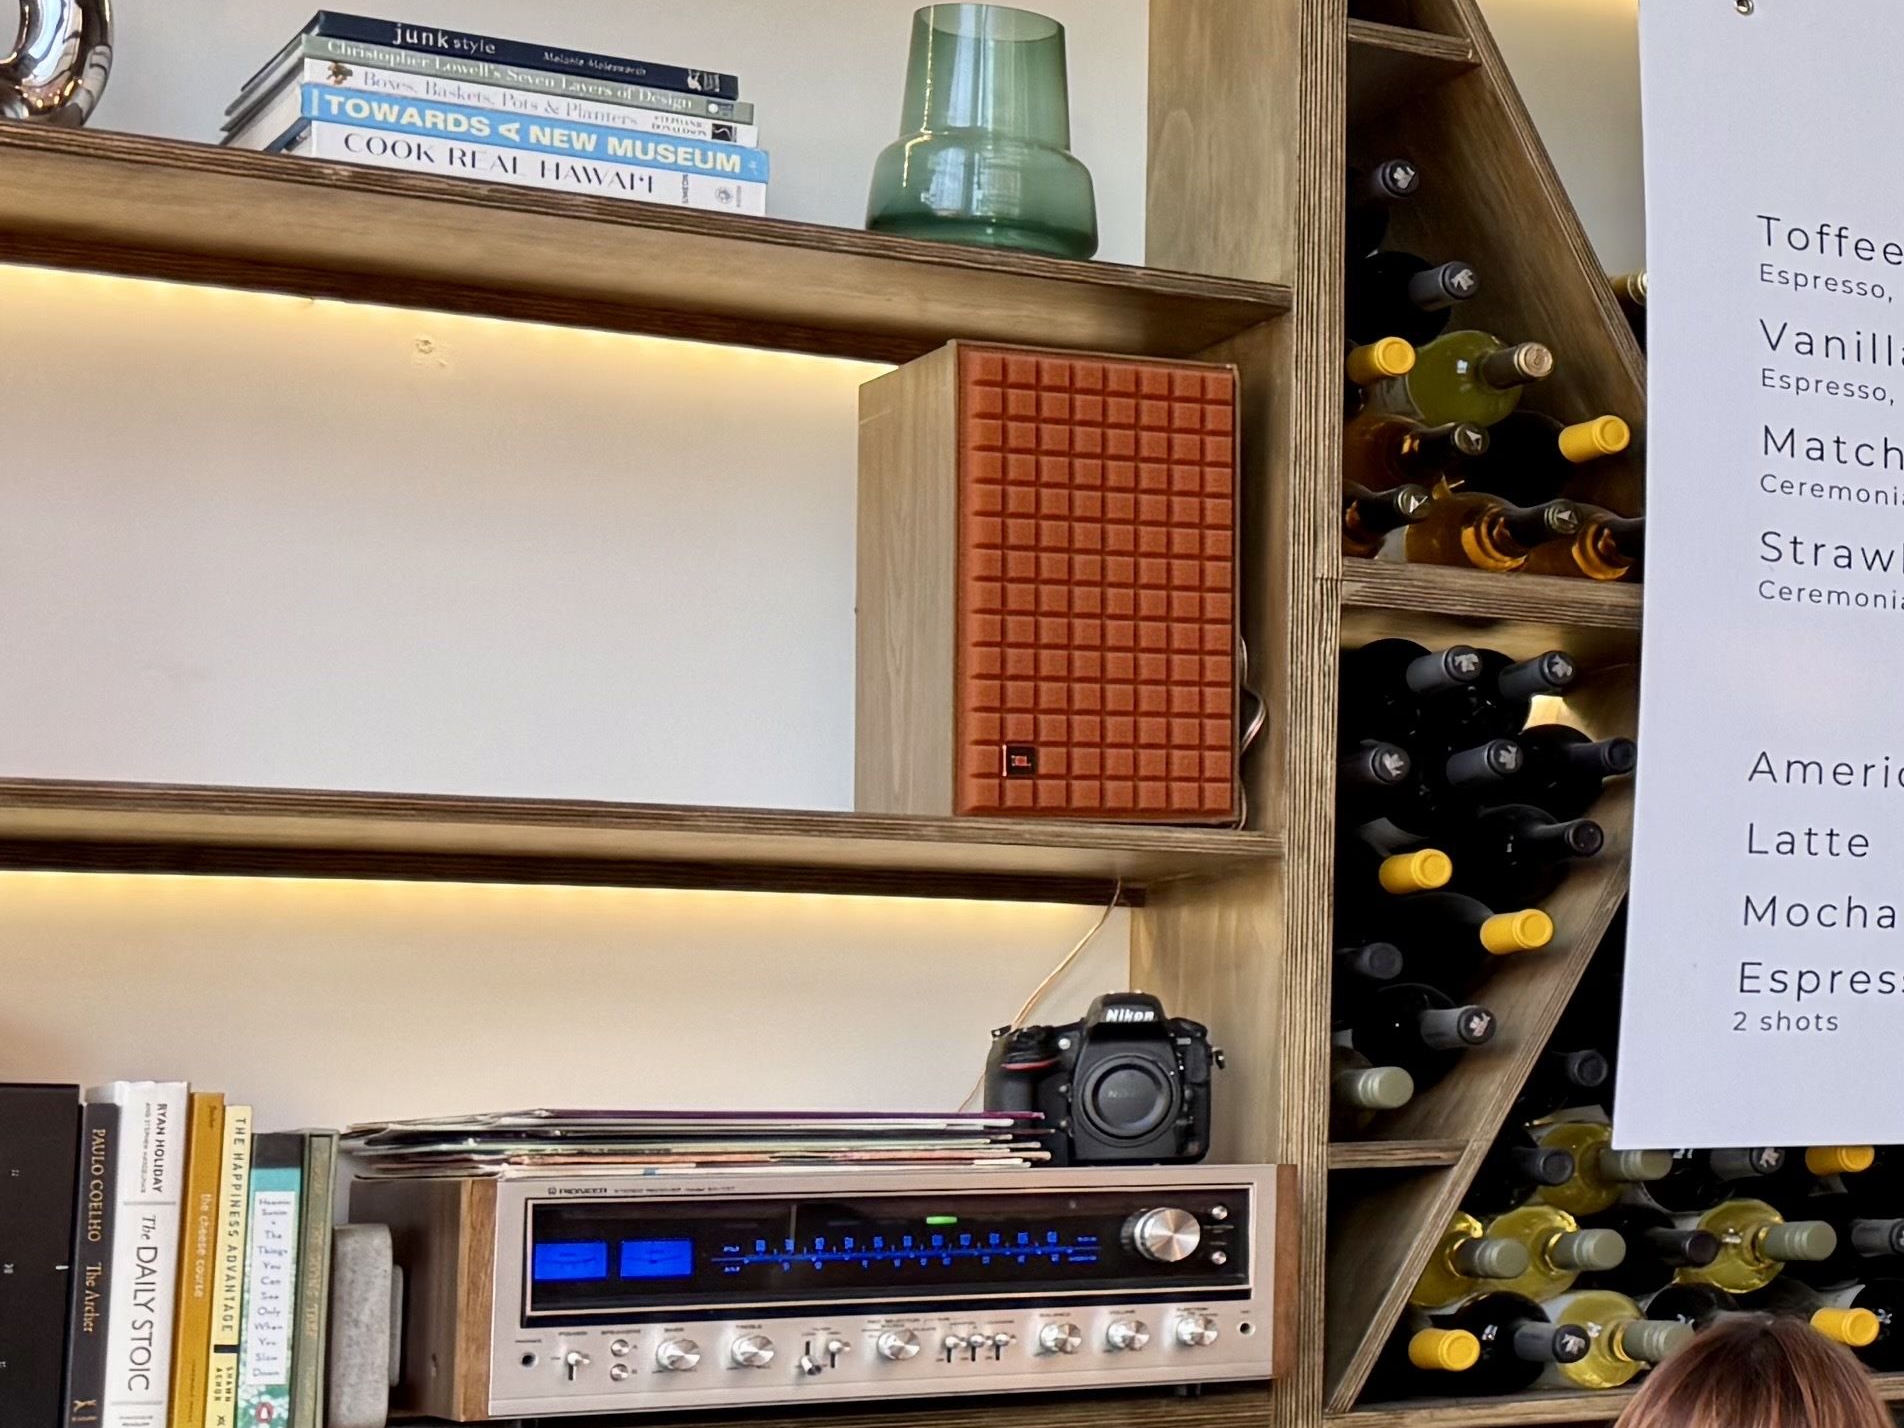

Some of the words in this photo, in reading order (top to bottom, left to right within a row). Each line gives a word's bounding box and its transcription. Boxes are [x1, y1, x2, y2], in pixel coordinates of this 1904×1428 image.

[393, 23, 448, 49] junk
[453, 38, 496, 54] style
[327, 40, 430, 69] Christopher
[507, 68, 554, 88] Seven
[562, 76, 613, 98] Layers
[617, 83, 632, 100] of
[639, 87, 693, 111] Design
[324, 94, 491, 137] TOWARDS
[528, 124, 598, 152] NEW
[607, 136, 741, 173] MUSEUM
[344, 132, 435, 164] COOK
[449, 146, 526, 176] REAL
[1757, 215, 1903, 265] Toffee
[1761, 263, 1892, 303] Espresso,
[1762, 368, 1894, 406] Espresso,
[1748, 823, 1869, 857] Latte
[1744, 895, 1895, 929] Mocha
[1105, 1008, 1155, 1023] Nikon
[1733, 1011, 1747, 1031] 2
[1760, 1010, 1838, 1031] shots
[155, 1103, 168, 1136] RYAN
[233, 1118, 247, 1145] THE
[91, 1128, 106, 1176] PAULO
[152, 1139, 166, 1193] HOLIDAY
[87, 1179, 104, 1242] COELHO
[227, 1152, 243, 1238] HAPPINESS
[140, 1213, 157, 1240] The
[86, 1262, 102, 1287] The
[133, 1246, 158, 1313] DAILY
[221, 1244, 239, 1332] ADVANTAGE
[83, 1291, 101, 1332] Archer
[128, 1319, 154, 1392] STOIC
